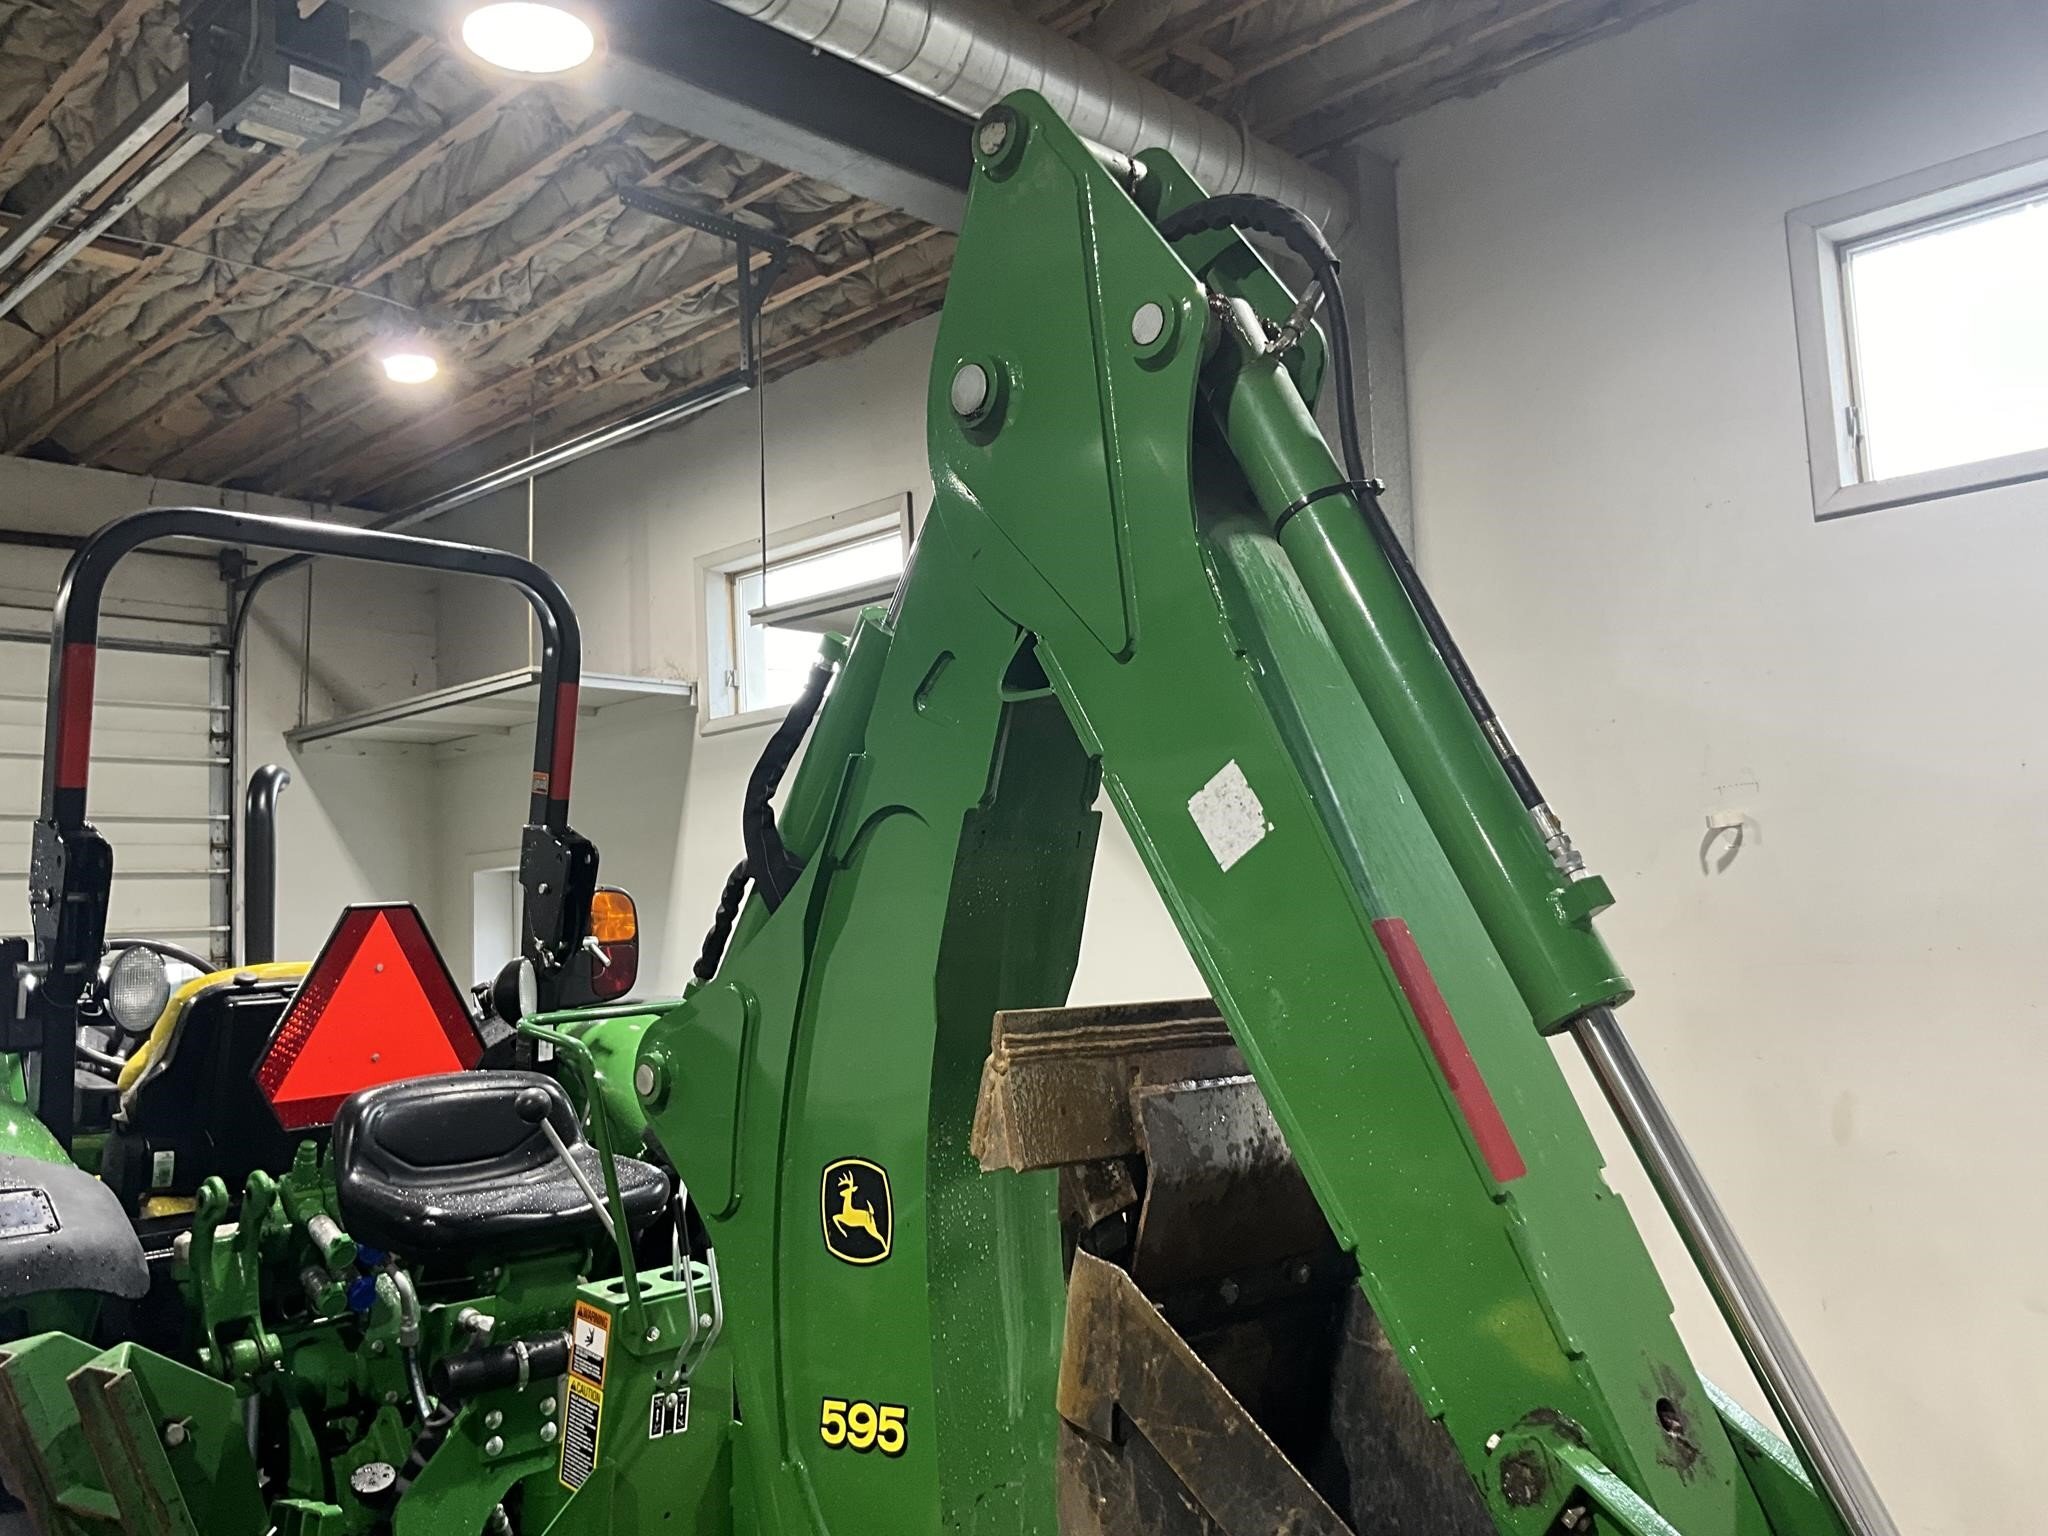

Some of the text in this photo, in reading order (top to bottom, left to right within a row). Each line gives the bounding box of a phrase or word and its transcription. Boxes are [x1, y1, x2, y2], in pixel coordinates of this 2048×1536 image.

[584, 1307, 608, 1329] WARNING
[576, 1384, 601, 1403] CAUTION
[820, 1398, 907, 1456] 595
